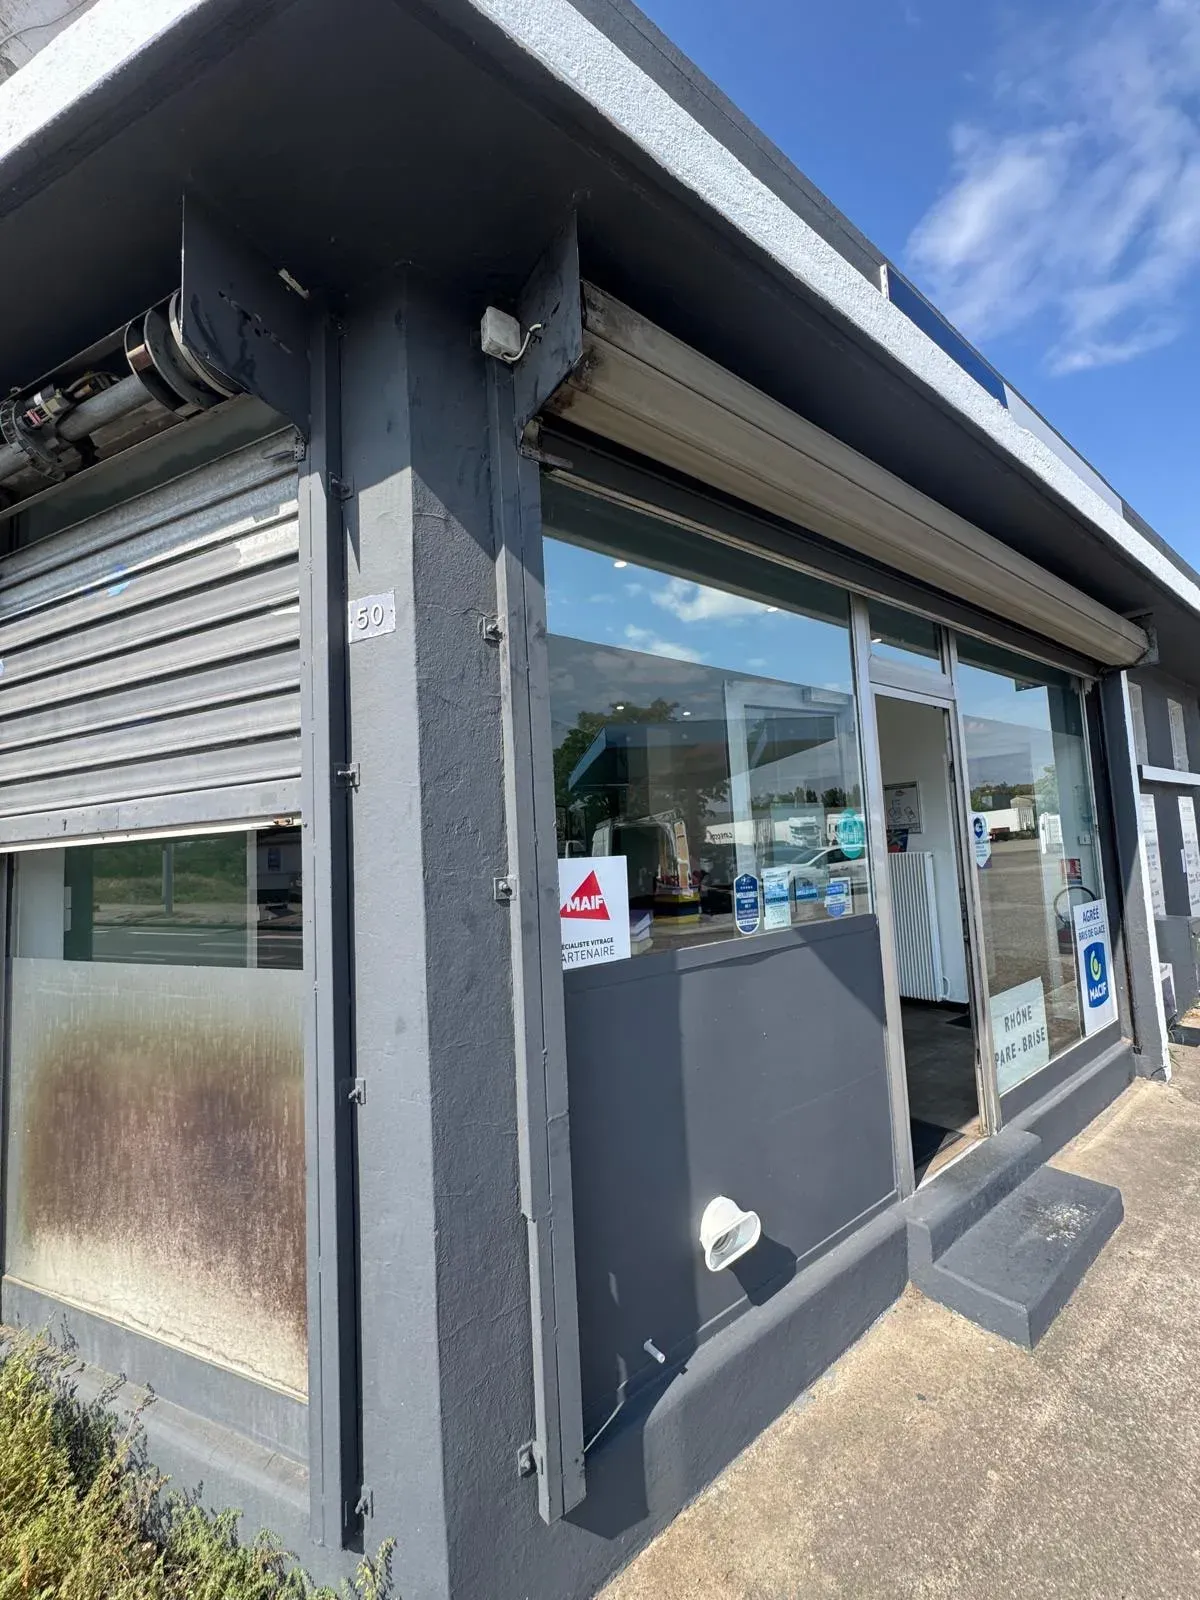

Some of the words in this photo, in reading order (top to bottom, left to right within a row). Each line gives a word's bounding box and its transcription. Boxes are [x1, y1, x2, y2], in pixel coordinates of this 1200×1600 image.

[356, 603, 384, 630] 50
[566, 894, 604, 913] MAIF
[591, 937, 614, 946] VITRAGE
[1079, 930, 1088, 941] BRIS
[1088, 928, 1094, 938] DE
[1094, 924, 1105, 936] GLACE
[1089, 981, 1107, 1002] MACIF
[1004, 1005, 1032, 1032] RHÔNE
[1022, 1026, 1046, 1052] BRISE
